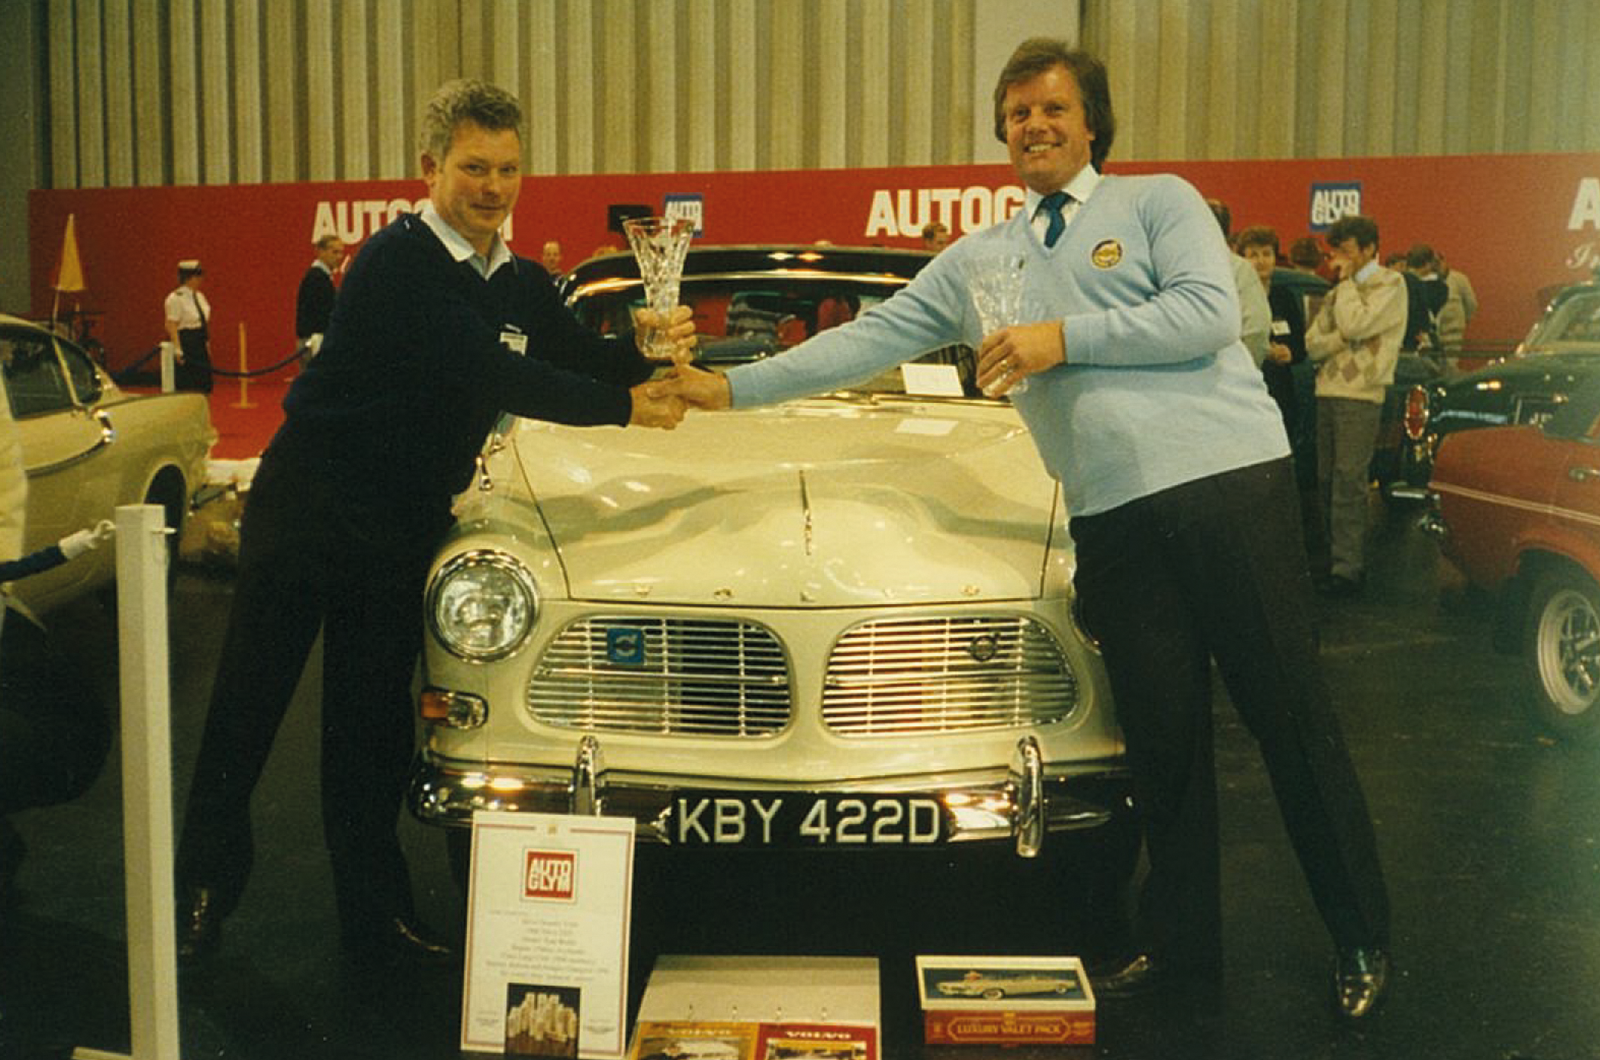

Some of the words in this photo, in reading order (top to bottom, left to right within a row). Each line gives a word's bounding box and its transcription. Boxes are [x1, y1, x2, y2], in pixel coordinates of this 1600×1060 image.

[678, 799, 782, 843] KBY
[800, 799, 940, 843] 422D
[530, 859, 571, 876] AUTO
[529, 873, 571, 890] GLYM
